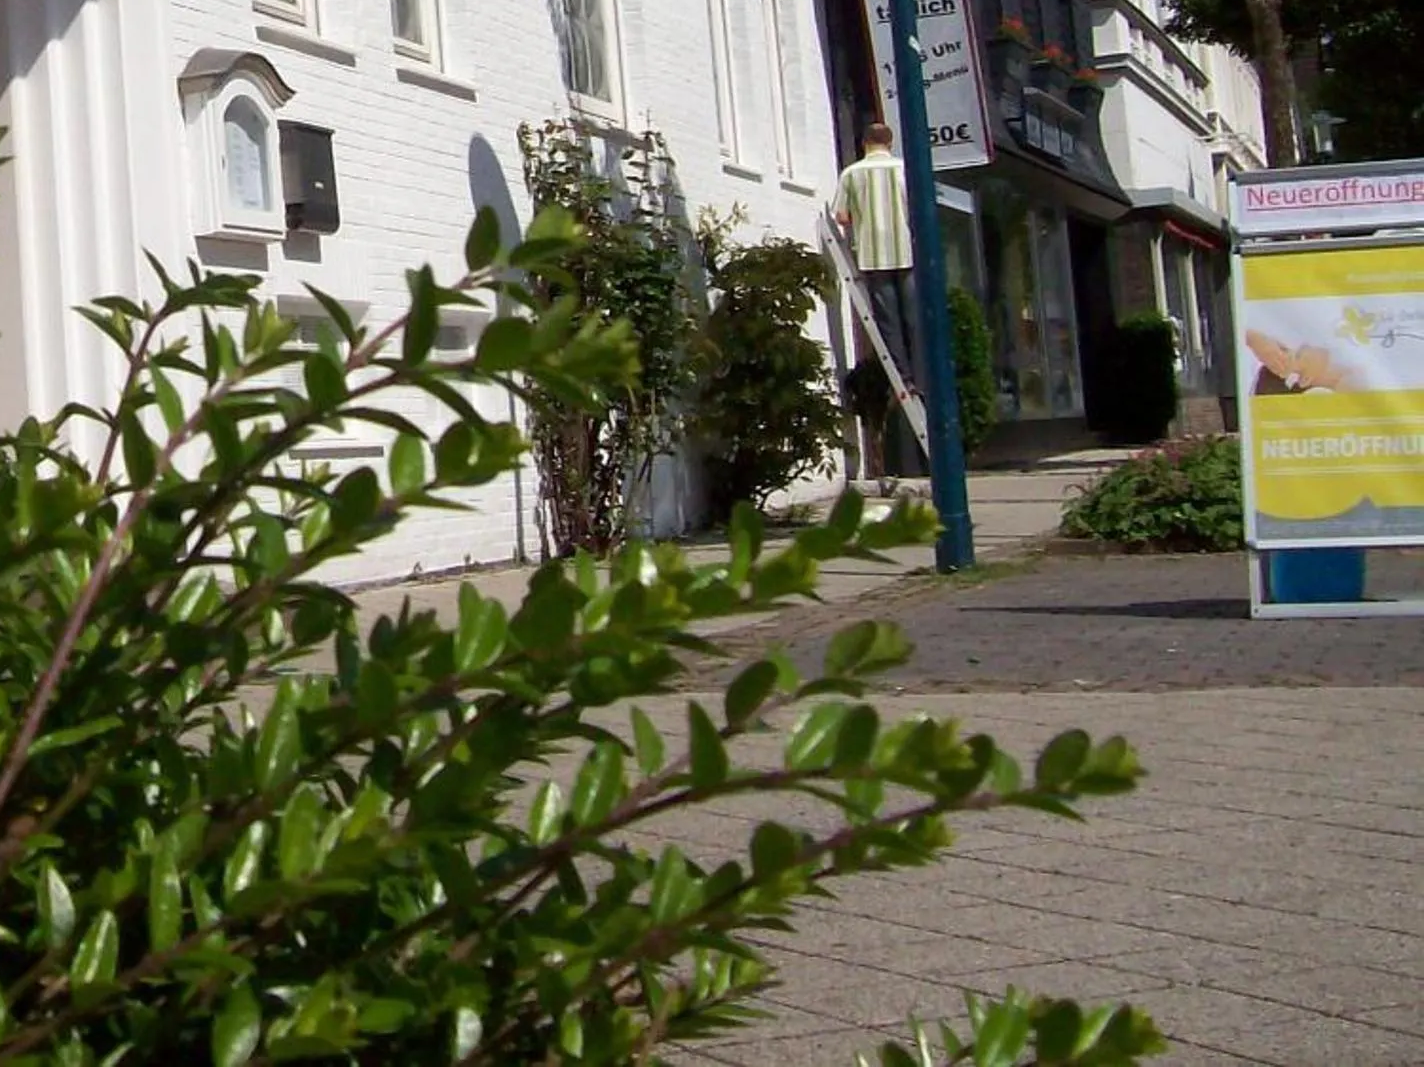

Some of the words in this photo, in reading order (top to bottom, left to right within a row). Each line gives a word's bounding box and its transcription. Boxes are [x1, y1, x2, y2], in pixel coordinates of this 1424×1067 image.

[931, 41, 962, 58] Uhr
[1247, 178, 1424, 207] Neueröffnung
[1262, 432, 1424, 460] NEUERÖFFNU
